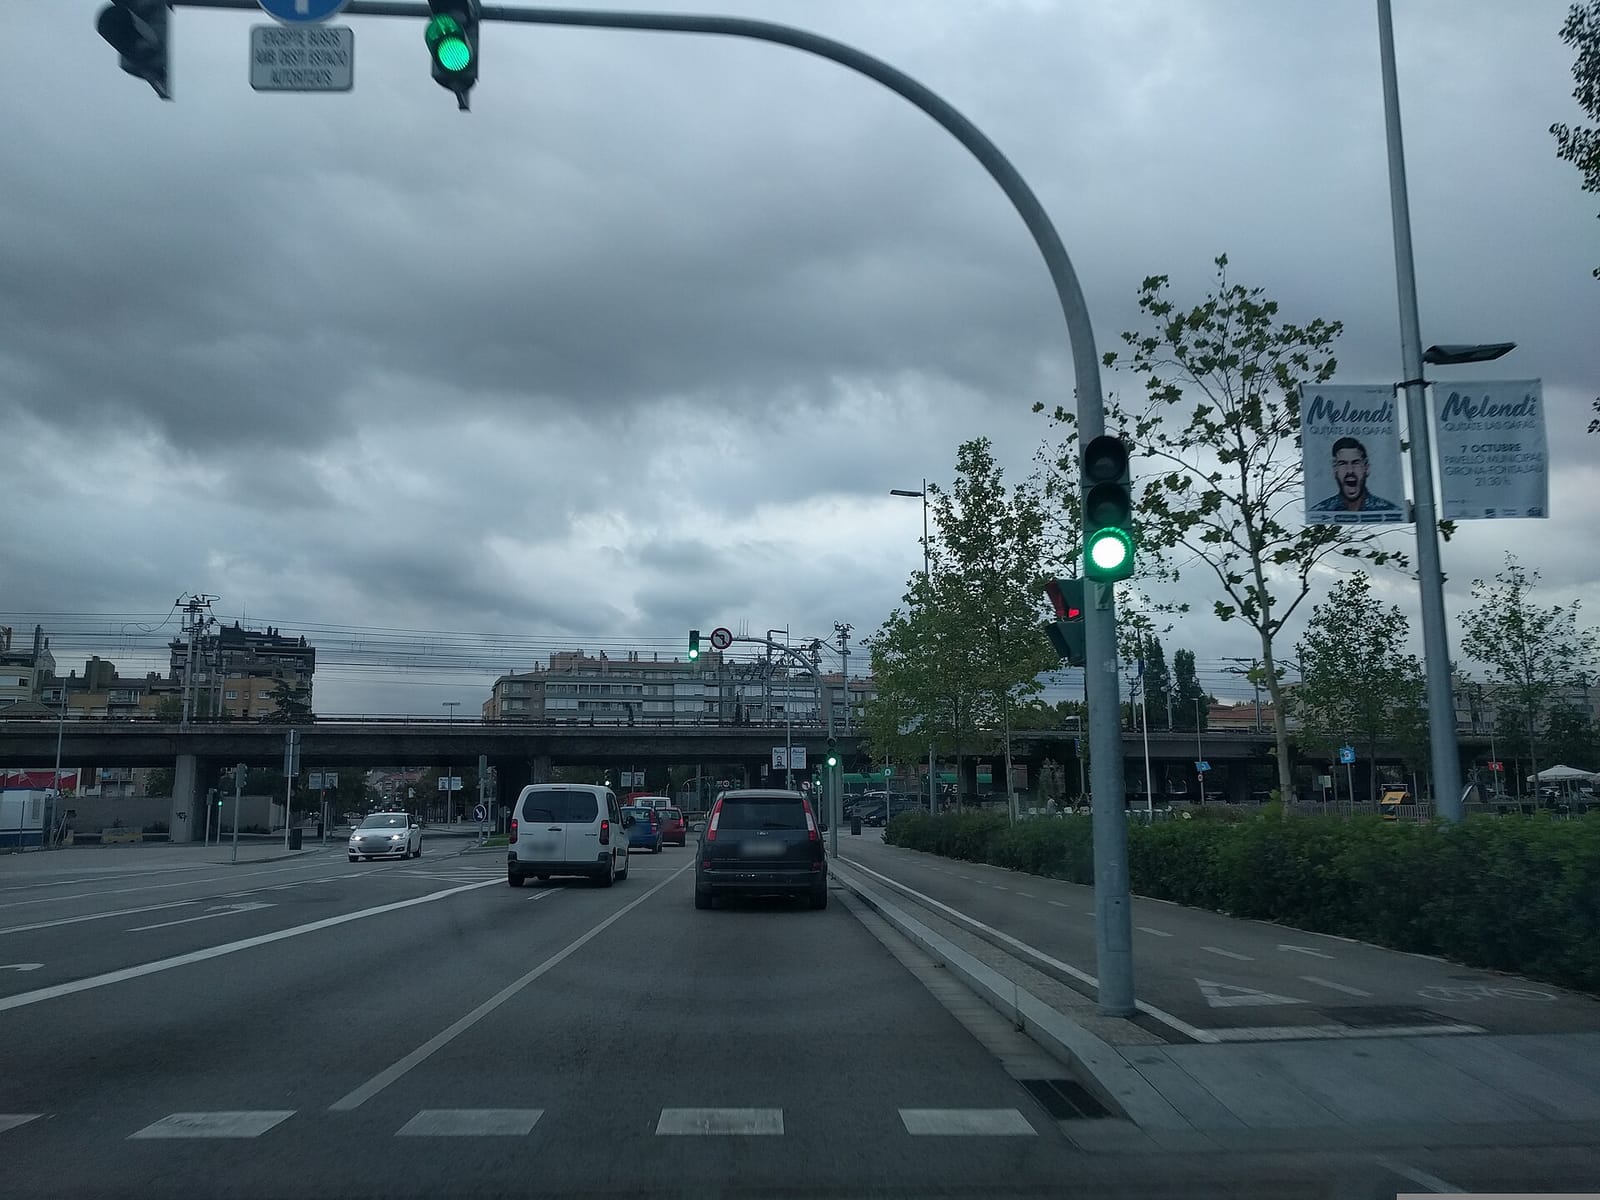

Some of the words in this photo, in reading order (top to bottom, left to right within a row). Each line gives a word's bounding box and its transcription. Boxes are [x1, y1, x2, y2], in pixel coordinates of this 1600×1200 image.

[1306, 395, 1394, 425] Melendi
[1440, 391, 1538, 422] Melendi
[1460, 444, 1468, 454] 7
[1471, 442, 1523, 453] OCTUBRE
